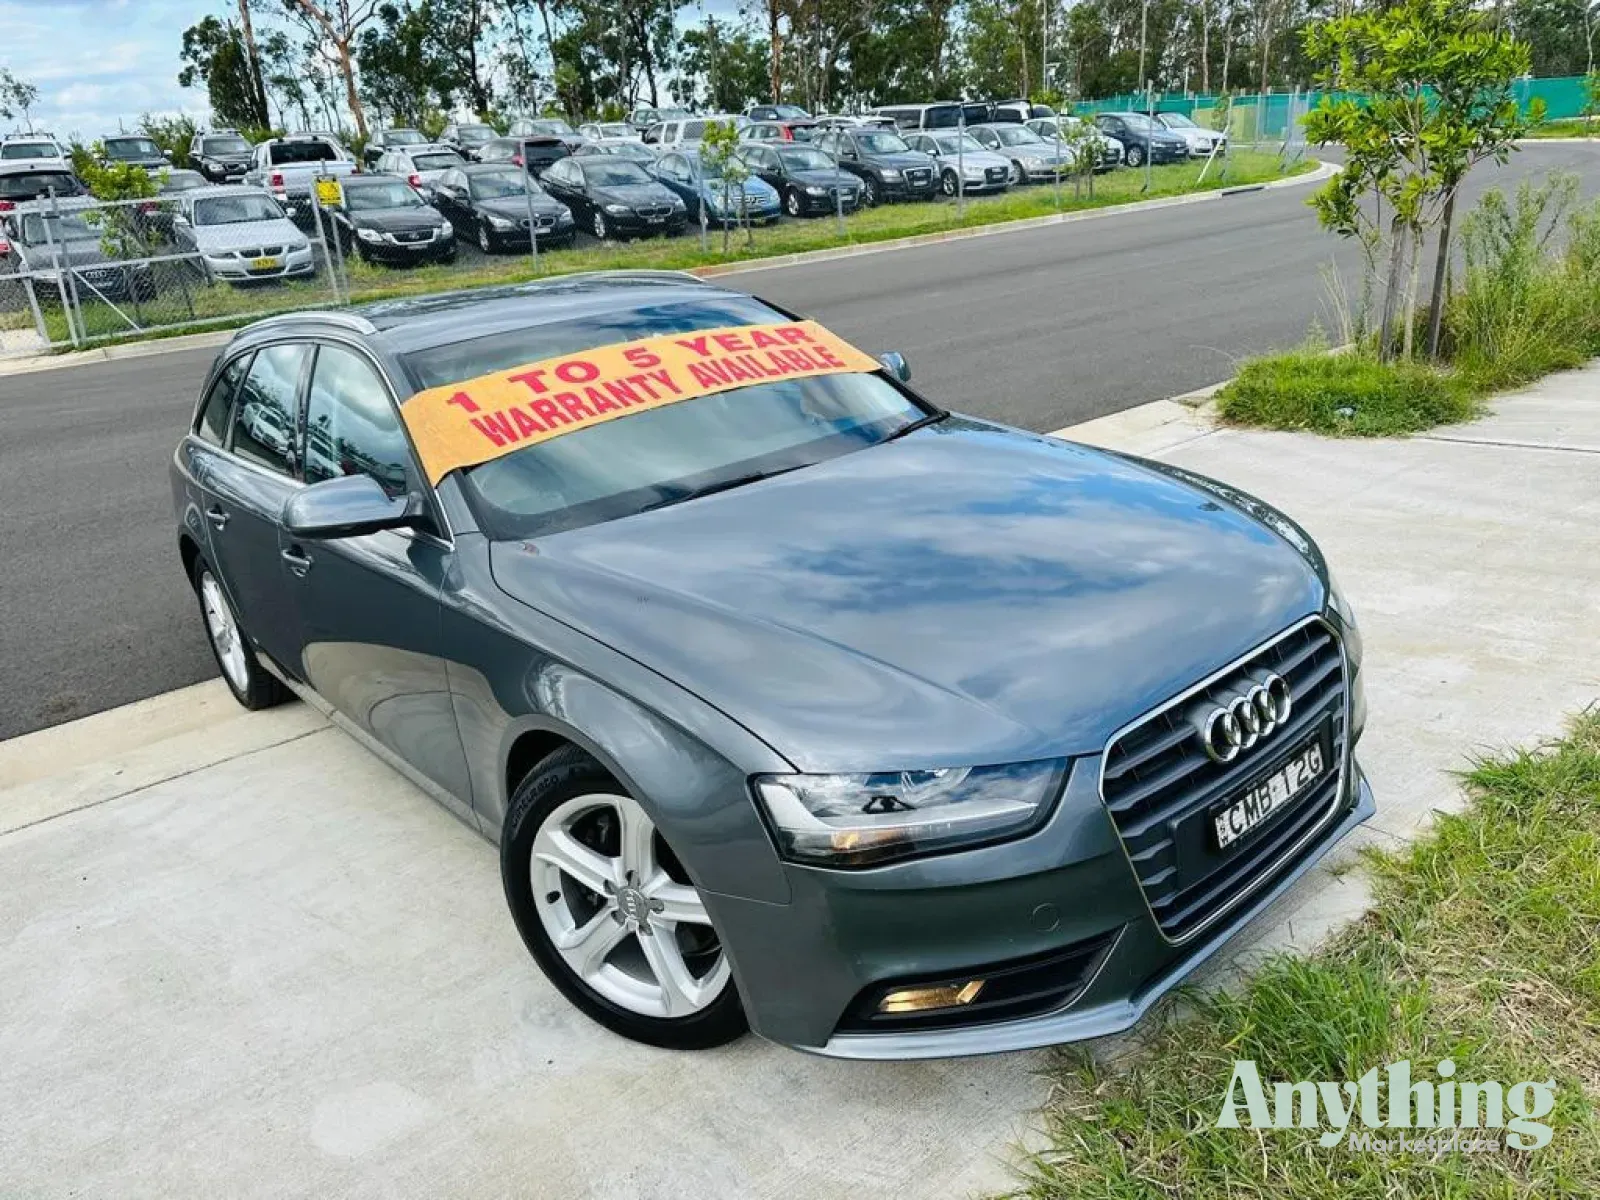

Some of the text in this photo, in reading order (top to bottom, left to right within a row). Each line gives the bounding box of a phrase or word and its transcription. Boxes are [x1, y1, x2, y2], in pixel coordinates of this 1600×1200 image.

[447, 327, 817, 413] 1 TO 5 YEAR
[469, 346, 846, 447] WARRANTY AVAILABLE
